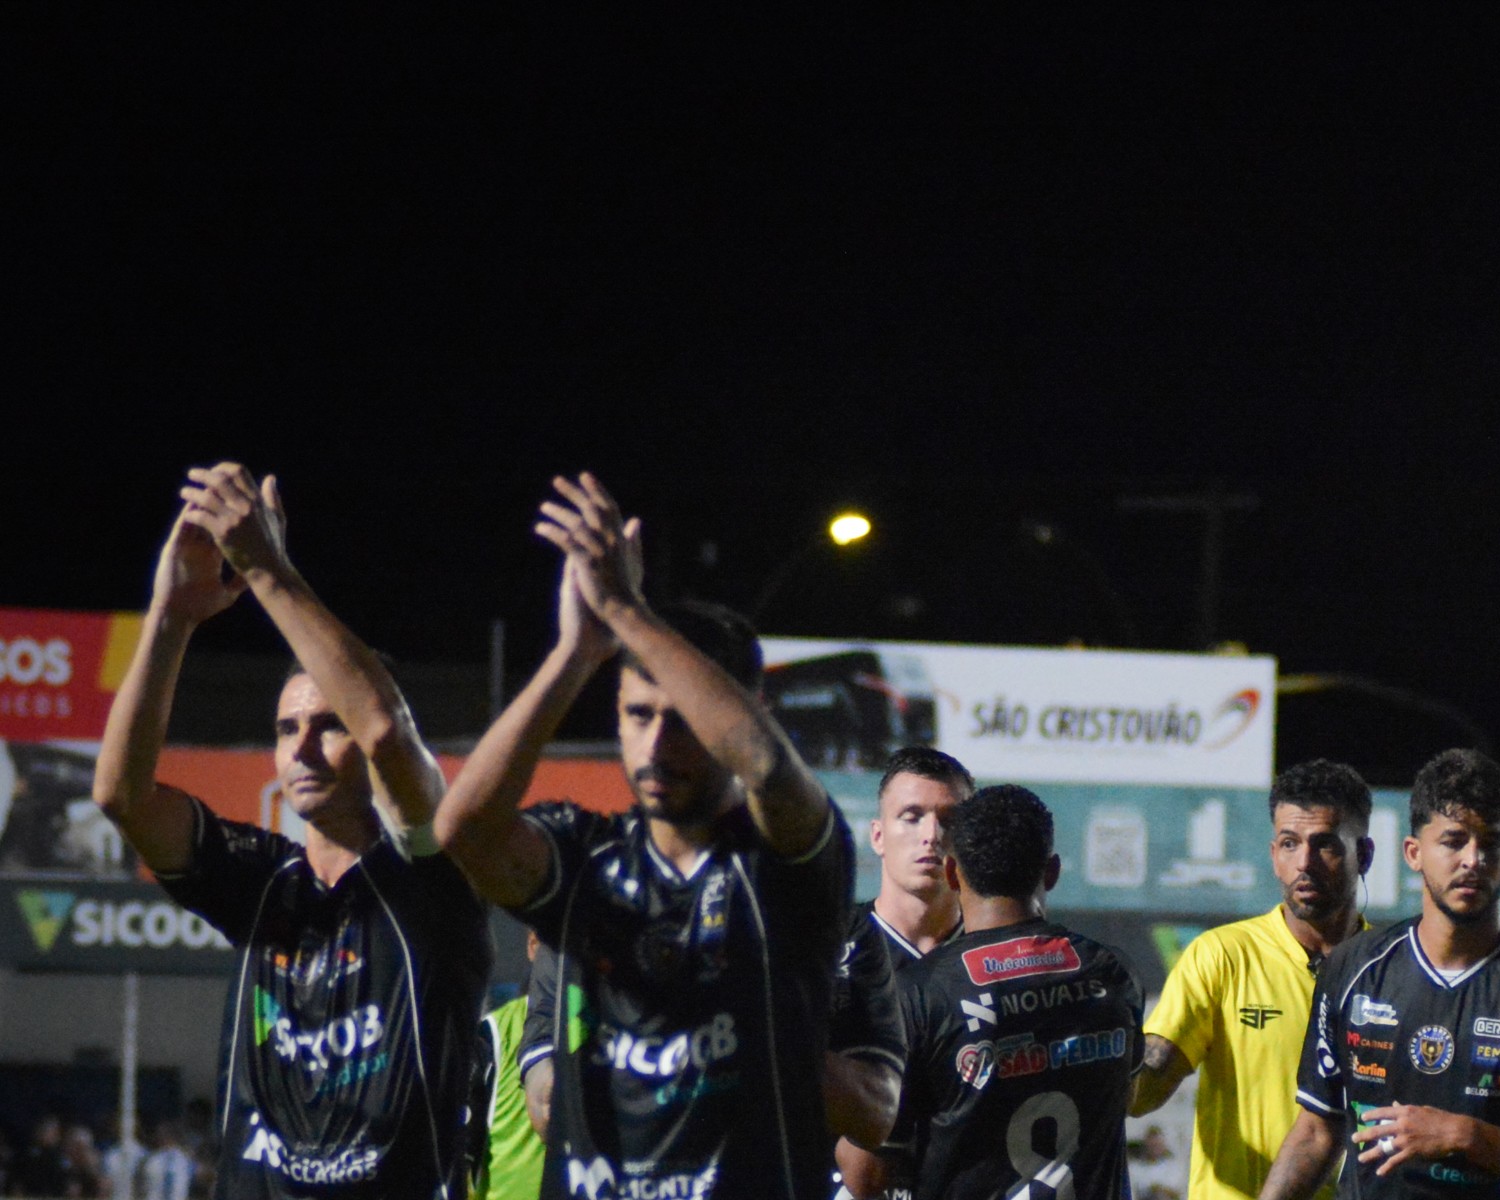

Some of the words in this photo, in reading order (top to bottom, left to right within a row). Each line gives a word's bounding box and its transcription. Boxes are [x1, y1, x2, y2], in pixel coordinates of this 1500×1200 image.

[0, 634, 72, 685] OS
[970, 694, 1029, 740] SÃO
[999, 979, 1108, 1017] NOVAIS
